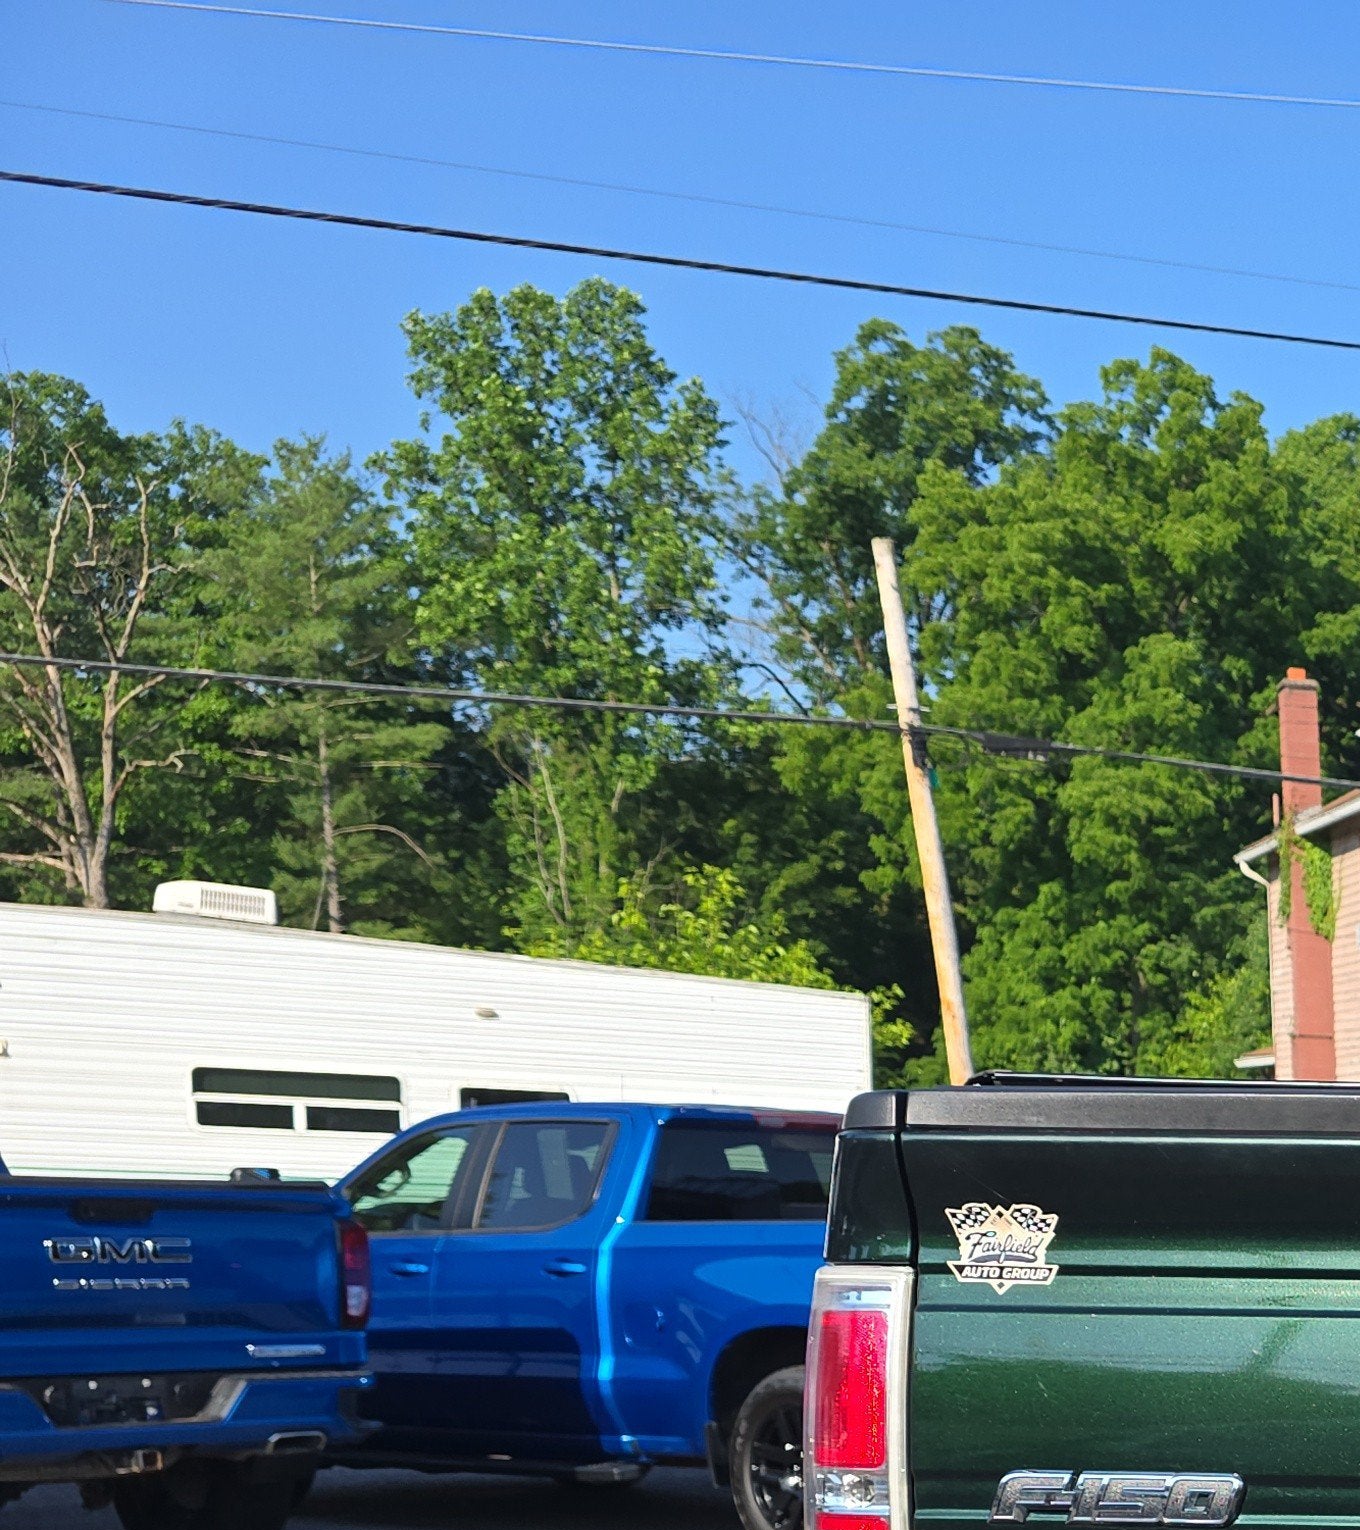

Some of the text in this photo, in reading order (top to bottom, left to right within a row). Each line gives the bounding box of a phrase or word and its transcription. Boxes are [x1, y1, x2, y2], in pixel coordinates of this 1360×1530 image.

[44, 1236, 193, 1264] GMC
[965, 1231, 1044, 1259] Fairfield
[961, 1266, 1050, 1280] AUTO GROUP
